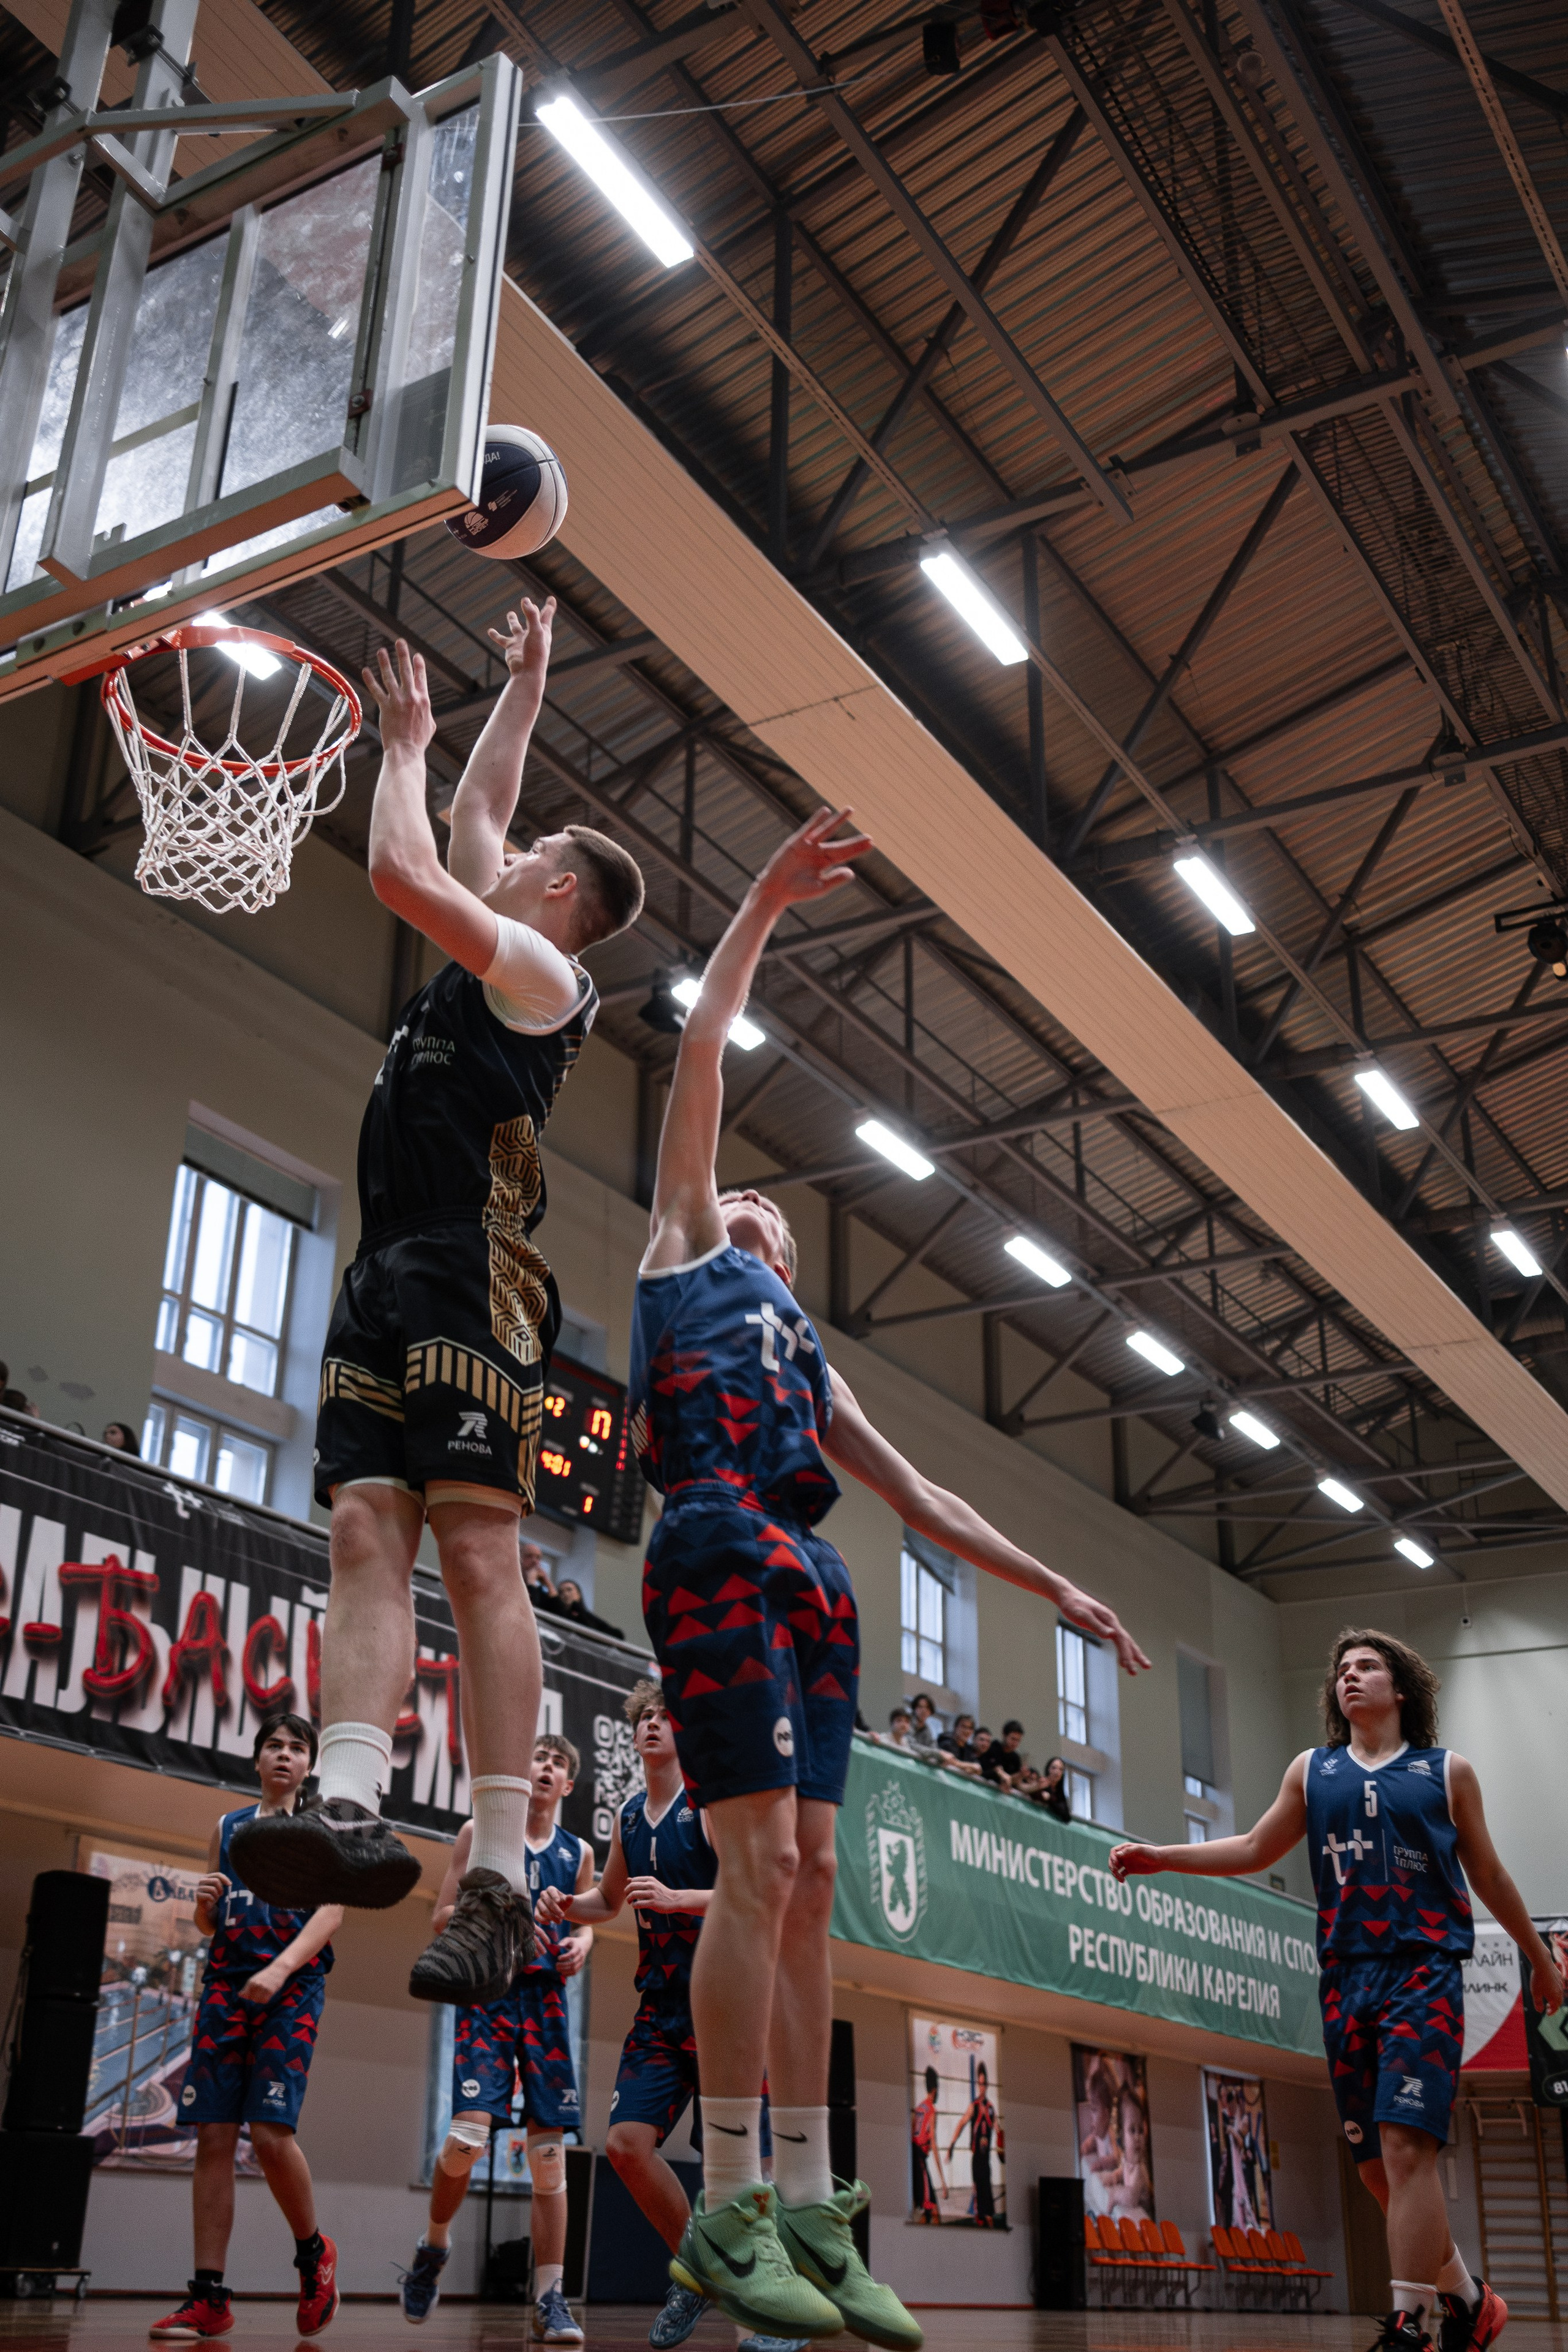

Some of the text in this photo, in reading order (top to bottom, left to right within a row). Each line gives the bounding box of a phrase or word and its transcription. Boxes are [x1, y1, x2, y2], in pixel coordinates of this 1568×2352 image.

[483, 451, 500, 464] ДА!
[447, 1440, 492, 1455] РЕНОВА
[1364, 1780, 1378, 1818] 5
[650, 1837, 657, 1871] 4
[1393, 1845, 1429, 1862] ГРУППА
[950, 1819, 1131, 1916] МИНИСТЕРСТВО
[1136, 1883, 1267, 1959] ОБРАЗОВАНИЯ
[1268, 1929, 1282, 1965] И
[1068, 1924, 1281, 2019] РЕСПУБЛИКИ КАРЕЛИЯ
[1393, 2095, 1425, 2108] РЕНОВА
